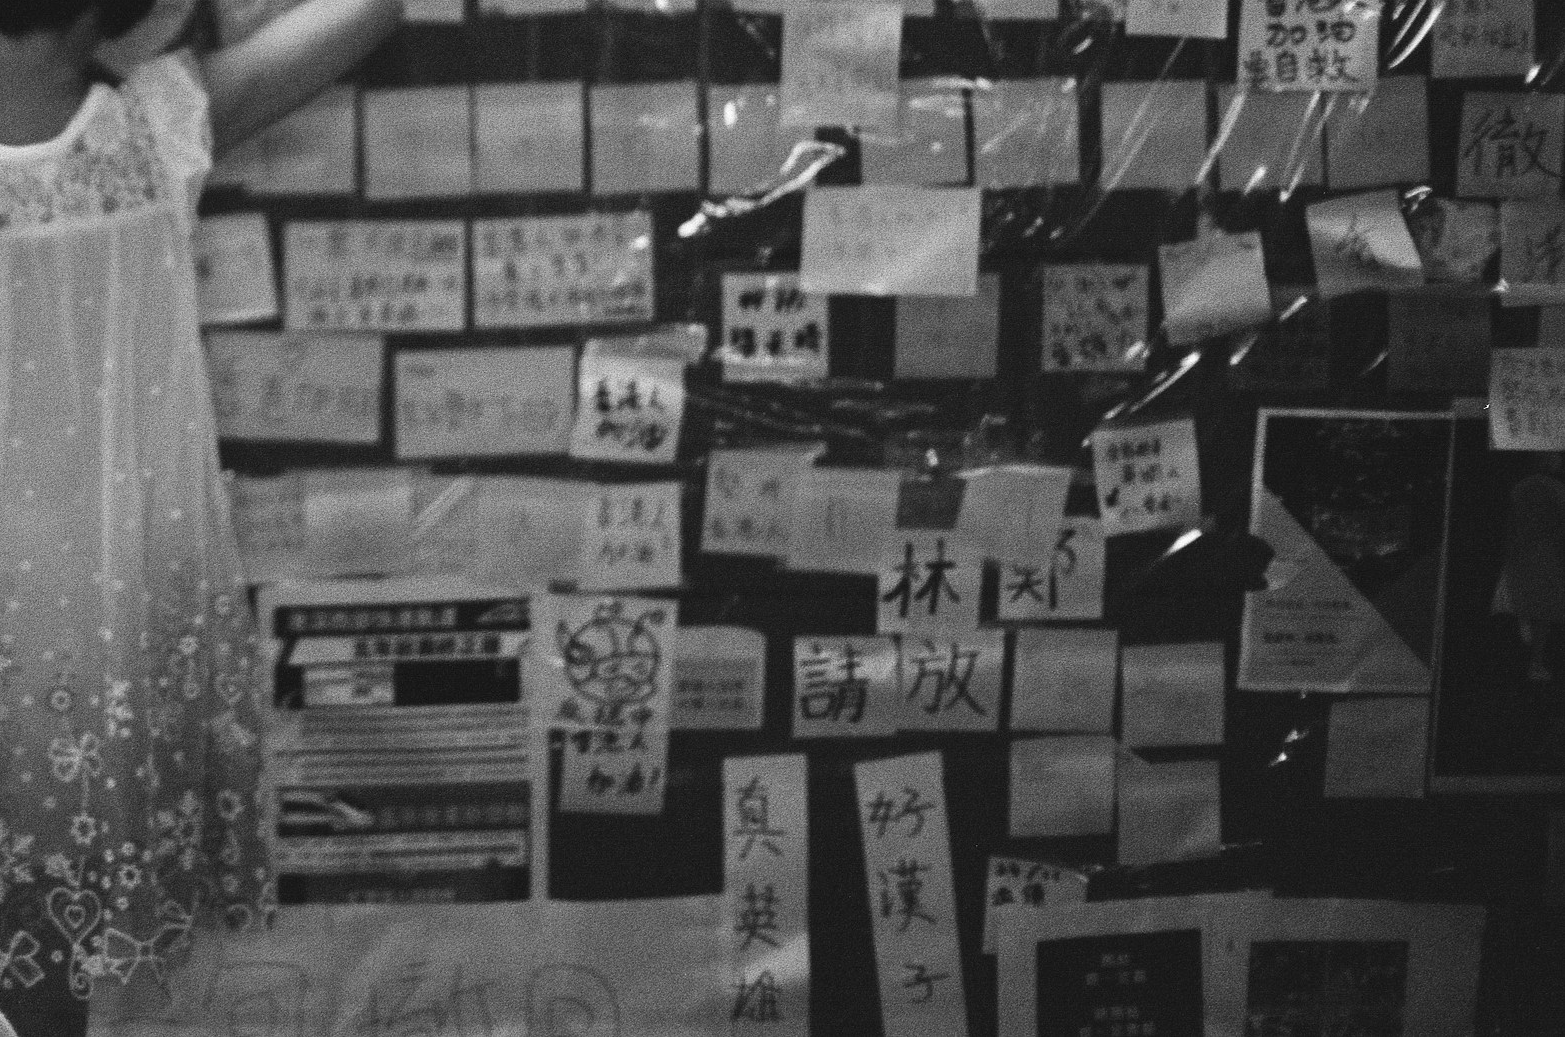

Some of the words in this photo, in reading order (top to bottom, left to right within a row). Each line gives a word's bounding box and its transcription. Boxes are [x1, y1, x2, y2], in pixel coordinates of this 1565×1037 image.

[1264, 20, 1357, 48] 加油
[1465, 108, 1564, 183] 徹
[731, 775, 784, 1025] 真英雄
[867, 786, 948, 1005] 好漢子
